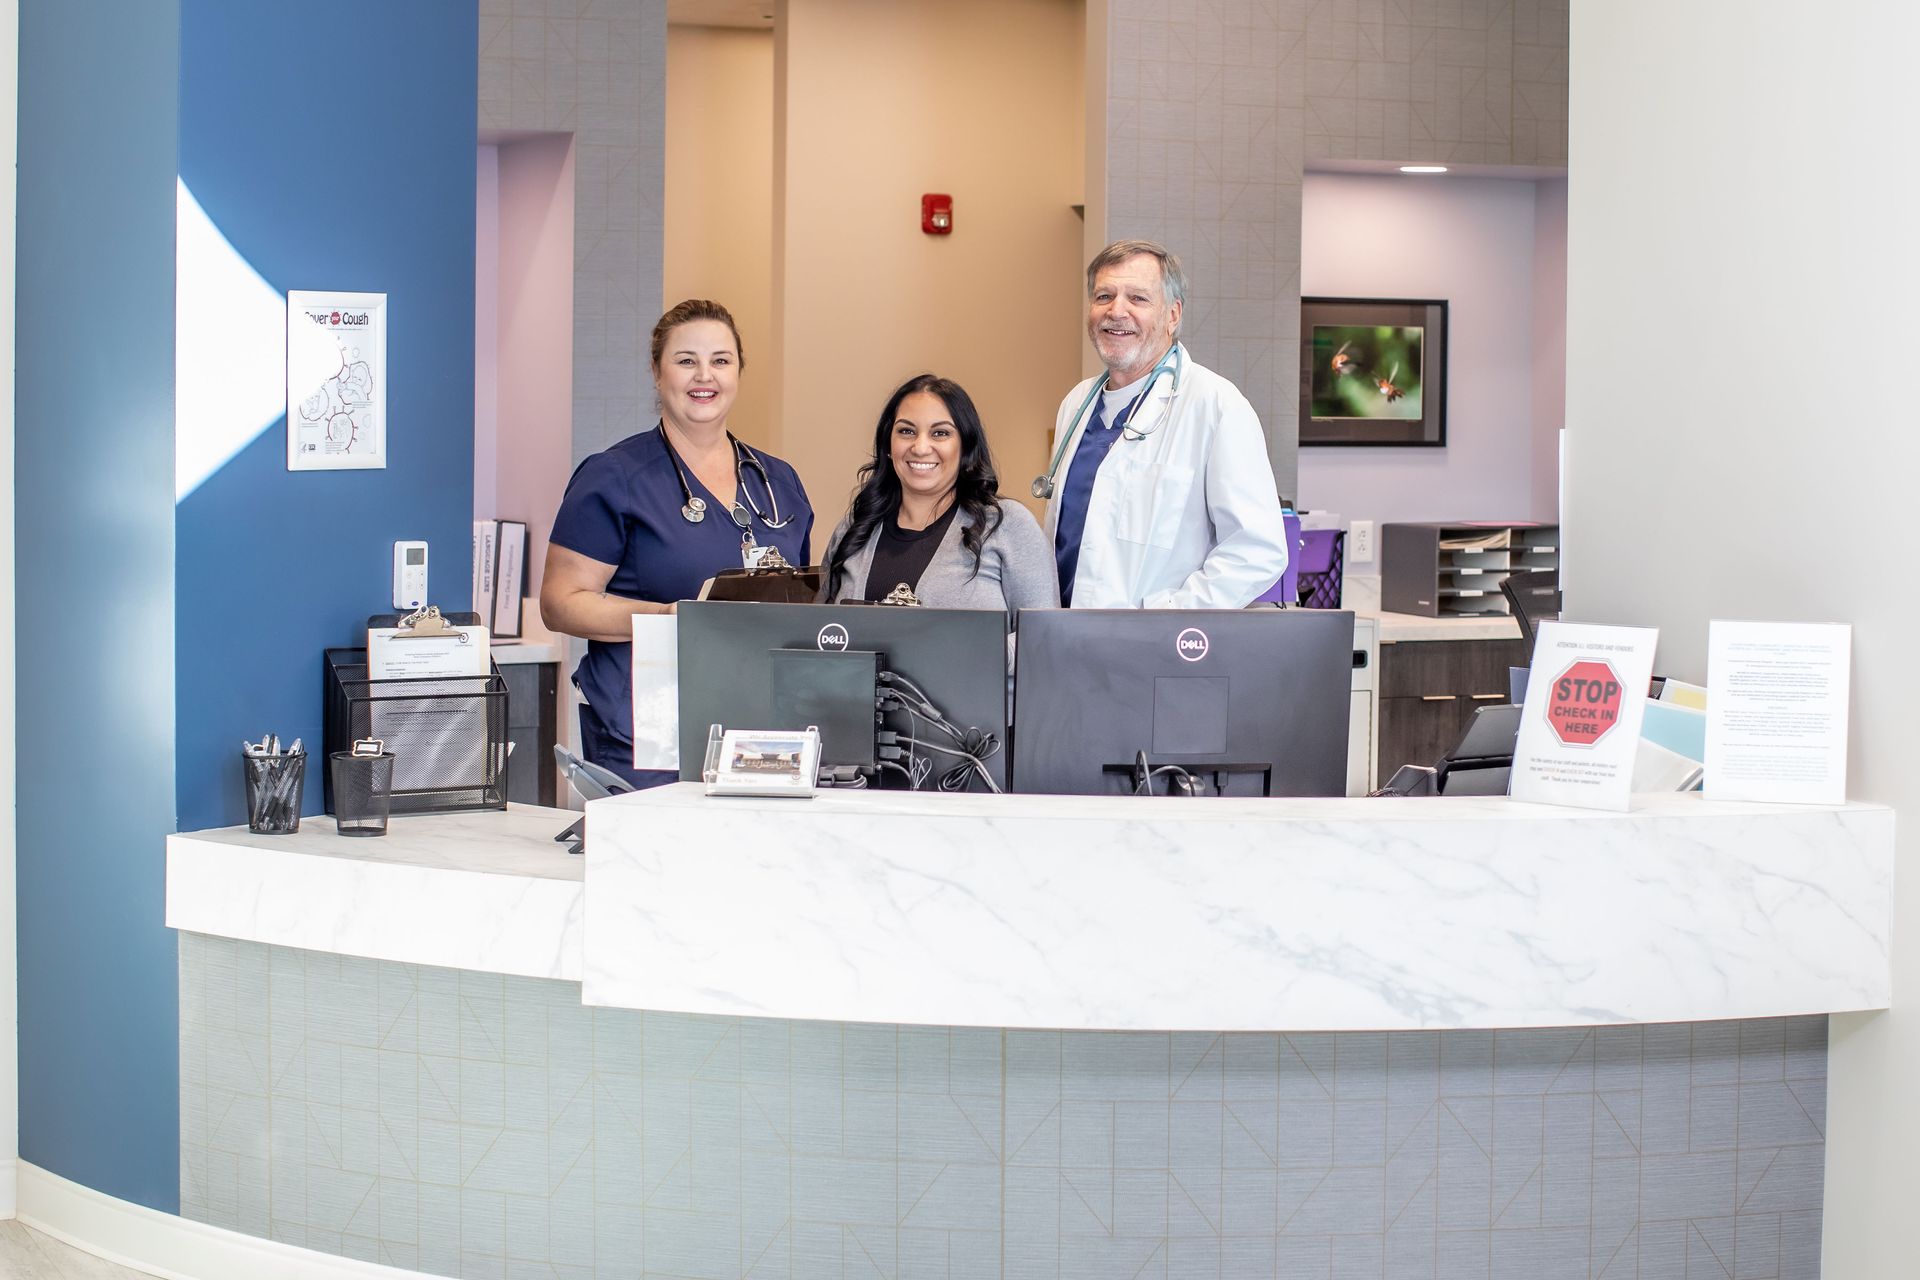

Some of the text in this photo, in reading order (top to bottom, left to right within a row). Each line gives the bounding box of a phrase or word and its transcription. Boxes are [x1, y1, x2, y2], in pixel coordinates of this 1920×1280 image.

[342, 312, 369, 325] Cough
[821, 635, 846, 644] DELL
[1180, 640, 1205, 650] DELL
[1556, 677, 1619, 705] STOP
[1554, 706, 1615, 721] CHECK IN
[1564, 722, 1599, 735] HERE
